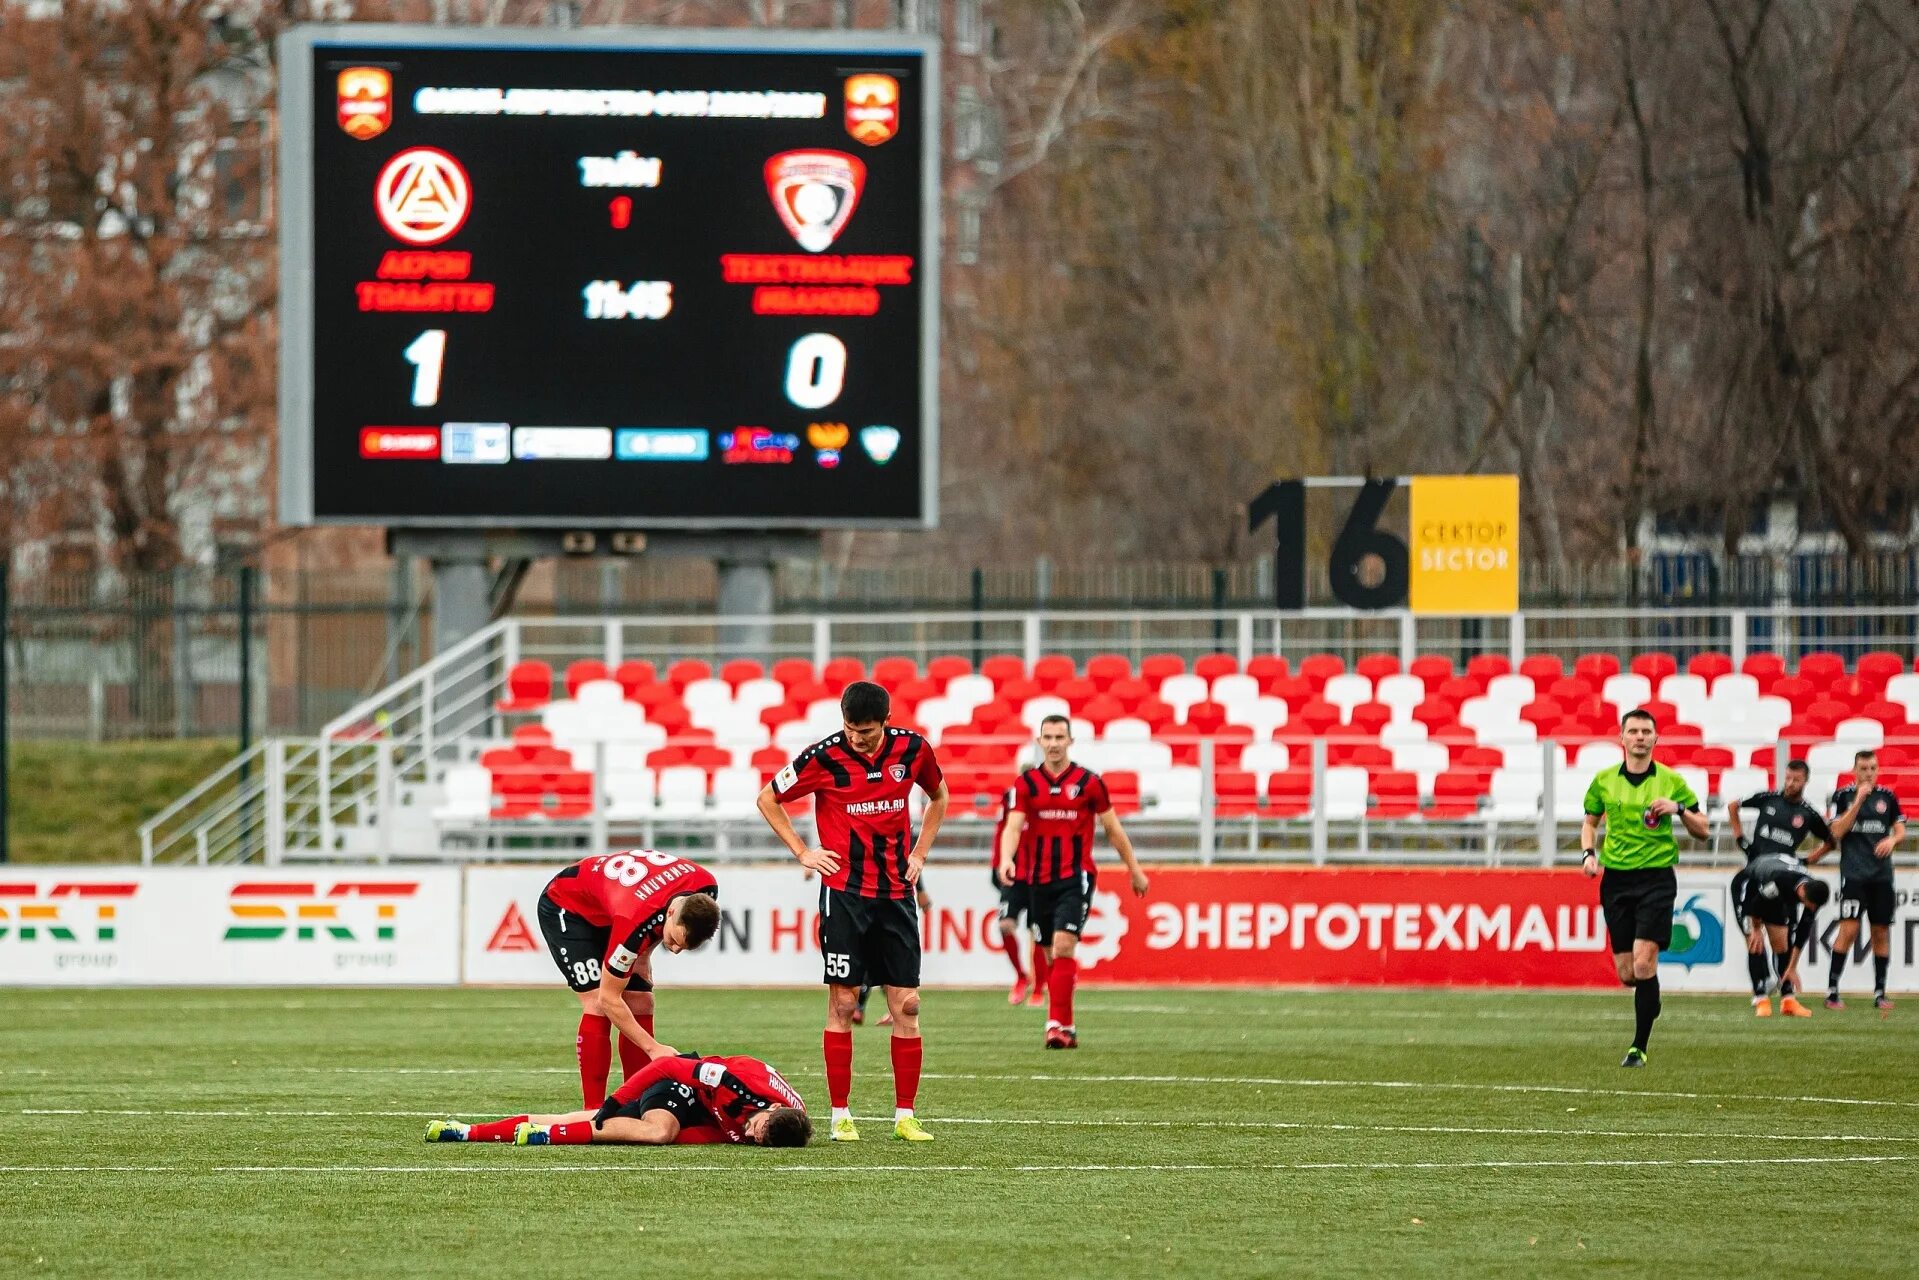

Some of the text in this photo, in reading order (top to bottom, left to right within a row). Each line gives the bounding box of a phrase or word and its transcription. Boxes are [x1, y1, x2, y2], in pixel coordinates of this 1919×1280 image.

[609, 195, 633, 230] 1
[402, 328, 447, 407] 1
[784, 332, 847, 410] 0
[1249, 477, 1410, 609] 16
[1419, 521, 1508, 544] СЕКТОР
[1420, 548, 1508, 572] SECTOR
[847, 799, 904, 814] IVASH-KA.RU
[224, 882, 420, 941] SKT
[1145, 902, 1606, 951] ЭНЕРГОТЕХМАШ
[54, 952, 118, 968] group
[334, 952, 397, 968] group
[573, 958, 601, 985] 88
[826, 952, 850, 978] 55
